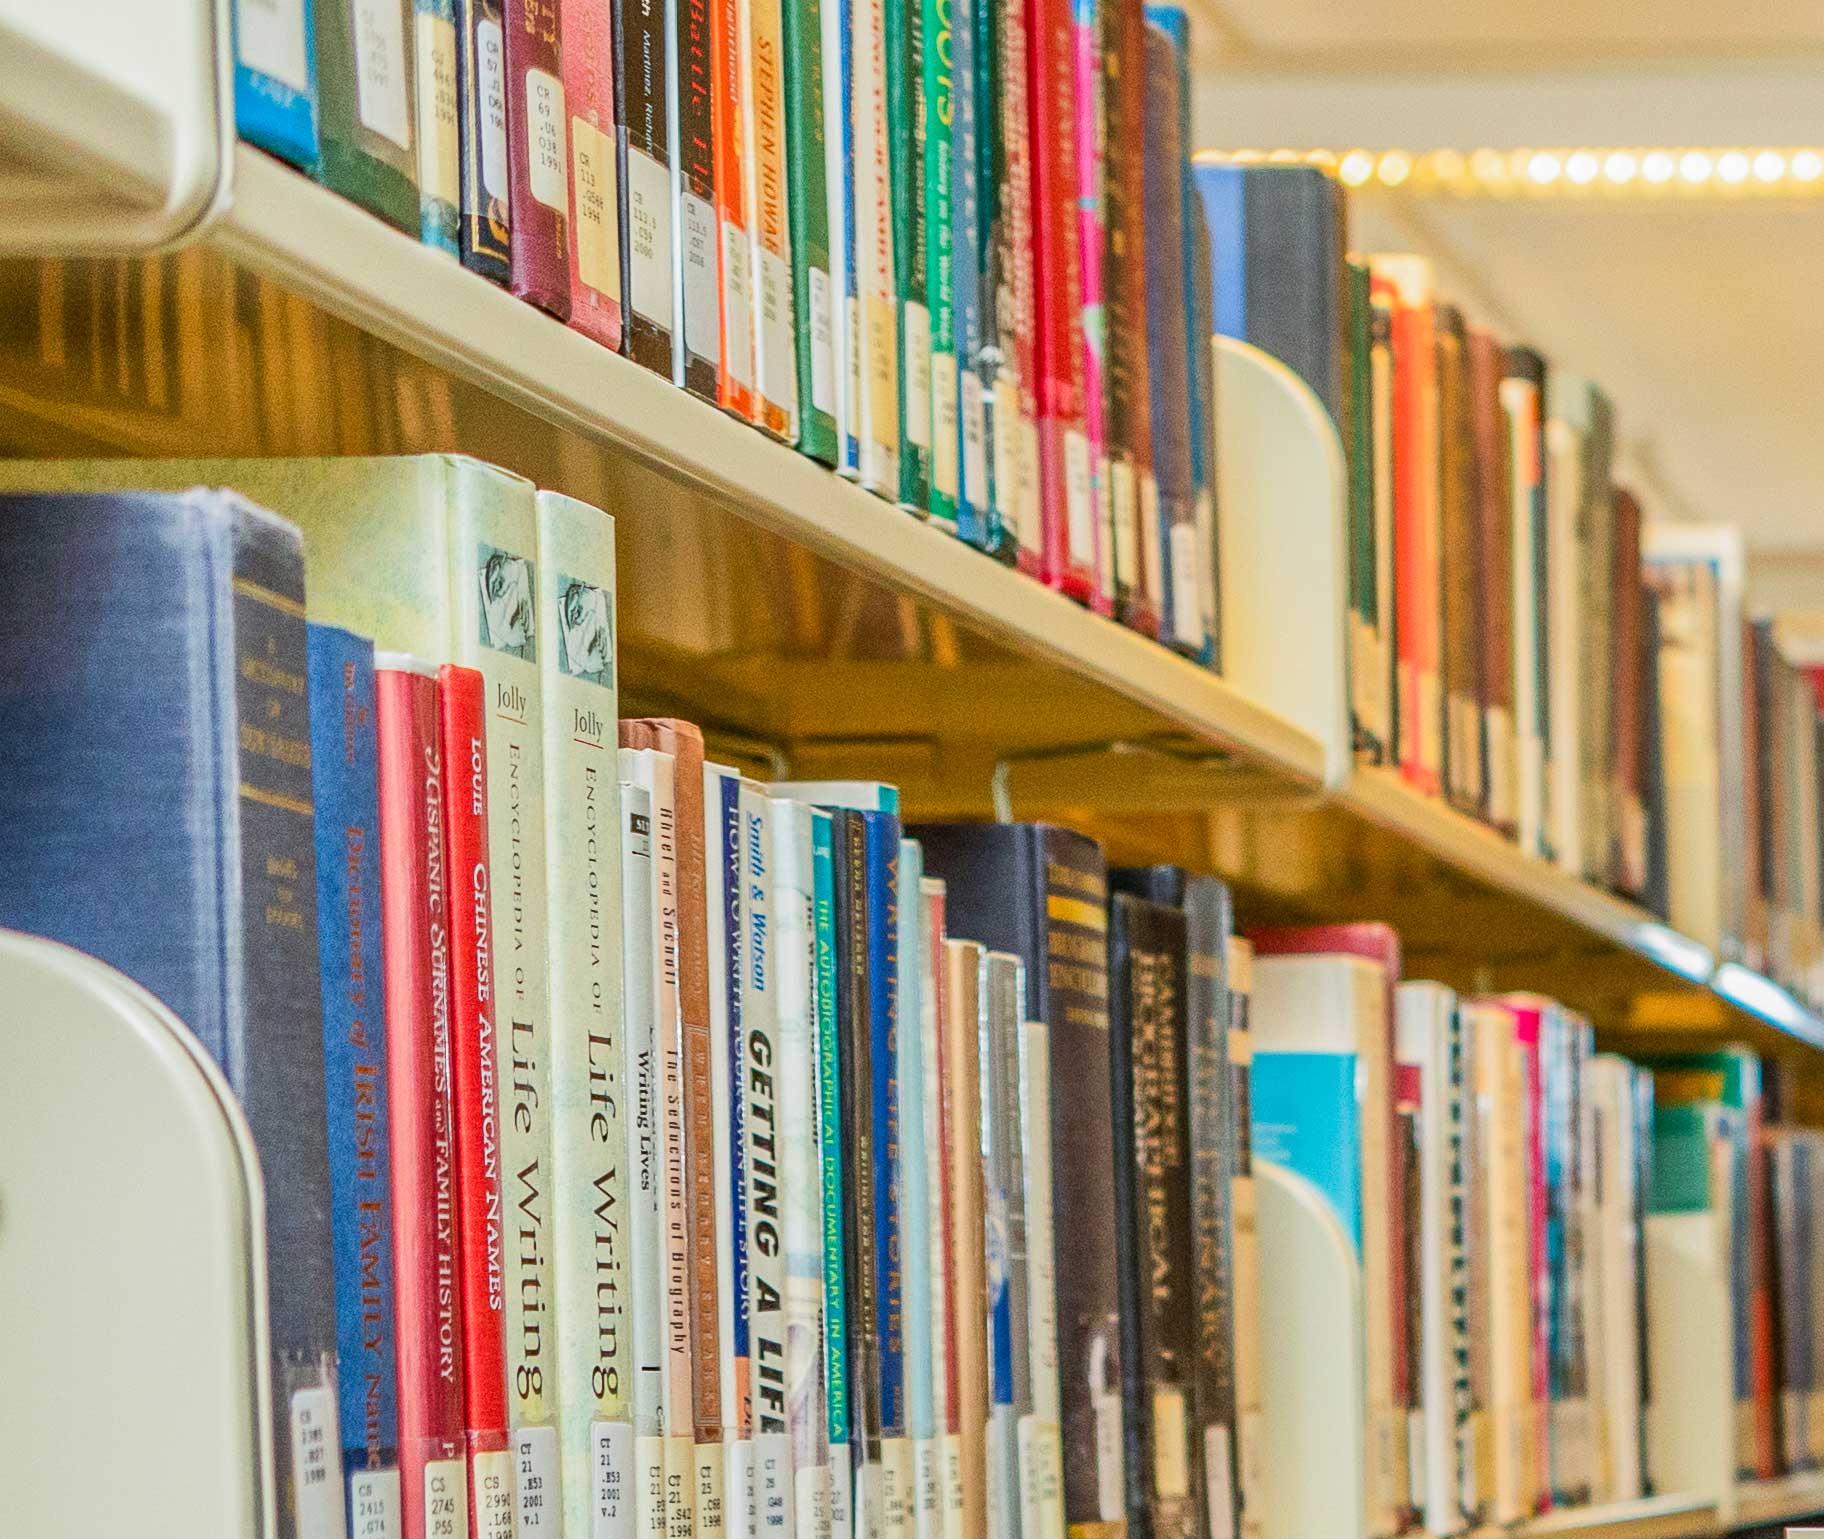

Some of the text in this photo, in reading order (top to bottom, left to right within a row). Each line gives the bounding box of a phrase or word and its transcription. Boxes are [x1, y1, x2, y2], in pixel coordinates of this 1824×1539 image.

[537, 104, 552, 117] 69
[758, 35, 778, 257] STEPHEN HOWAR
[497, 682, 528, 718] Jolly
[573, 708, 604, 743] Jolly
[660, 807, 674, 863] Rhiel
[727, 806, 741, 878] HOW
[662, 871, 673, 896] and
[746, 810, 768, 993] Smith & Watson
[430, 924, 448, 1092] SURNAMES
[471, 736, 503, 1311] LOUIE CHINESE AMERICAN NAMES
[509, 742, 546, 1401] ENCYCLOPEDIA OF Life Writing
[585, 765, 621, 1401] ENCYCLOPEDIA OF Life Writing
[637, 1048, 651, 1193] Writing Lives
[819, 899, 844, 1438] THE AUTOBIOGRAPHICAL DOCUMENTARY IN AMERICA
[436, 1138, 453, 1248] FAMILY
[666, 1050, 686, 1355] The Seductions of Biography
[749, 1027, 787, 1434] GETTING A LIFE
[439, 1254, 456, 1384] HISTORY
[521, 1443, 532, 1456] CT
[600, 1438, 611, 1449] CT
[522, 1460, 533, 1473] 21
[600, 1454, 611, 1467] 21
[668, 1475, 681, 1488] CT
[700, 1465, 711, 1478] CT
[431, 1477, 446, 1493] CS
[484, 1476, 500, 1490] CS
[701, 1483, 712, 1495] 25
[523, 1495, 543, 1509] 2001
[601, 1488, 621, 1501] 2001
[669, 1491, 682, 1504] 21
[431, 1499, 455, 1515] 2745
[601, 1506, 617, 1518] v.2
[432, 1520, 453, 1536] .P55
[524, 1513, 540, 1526] v.1
